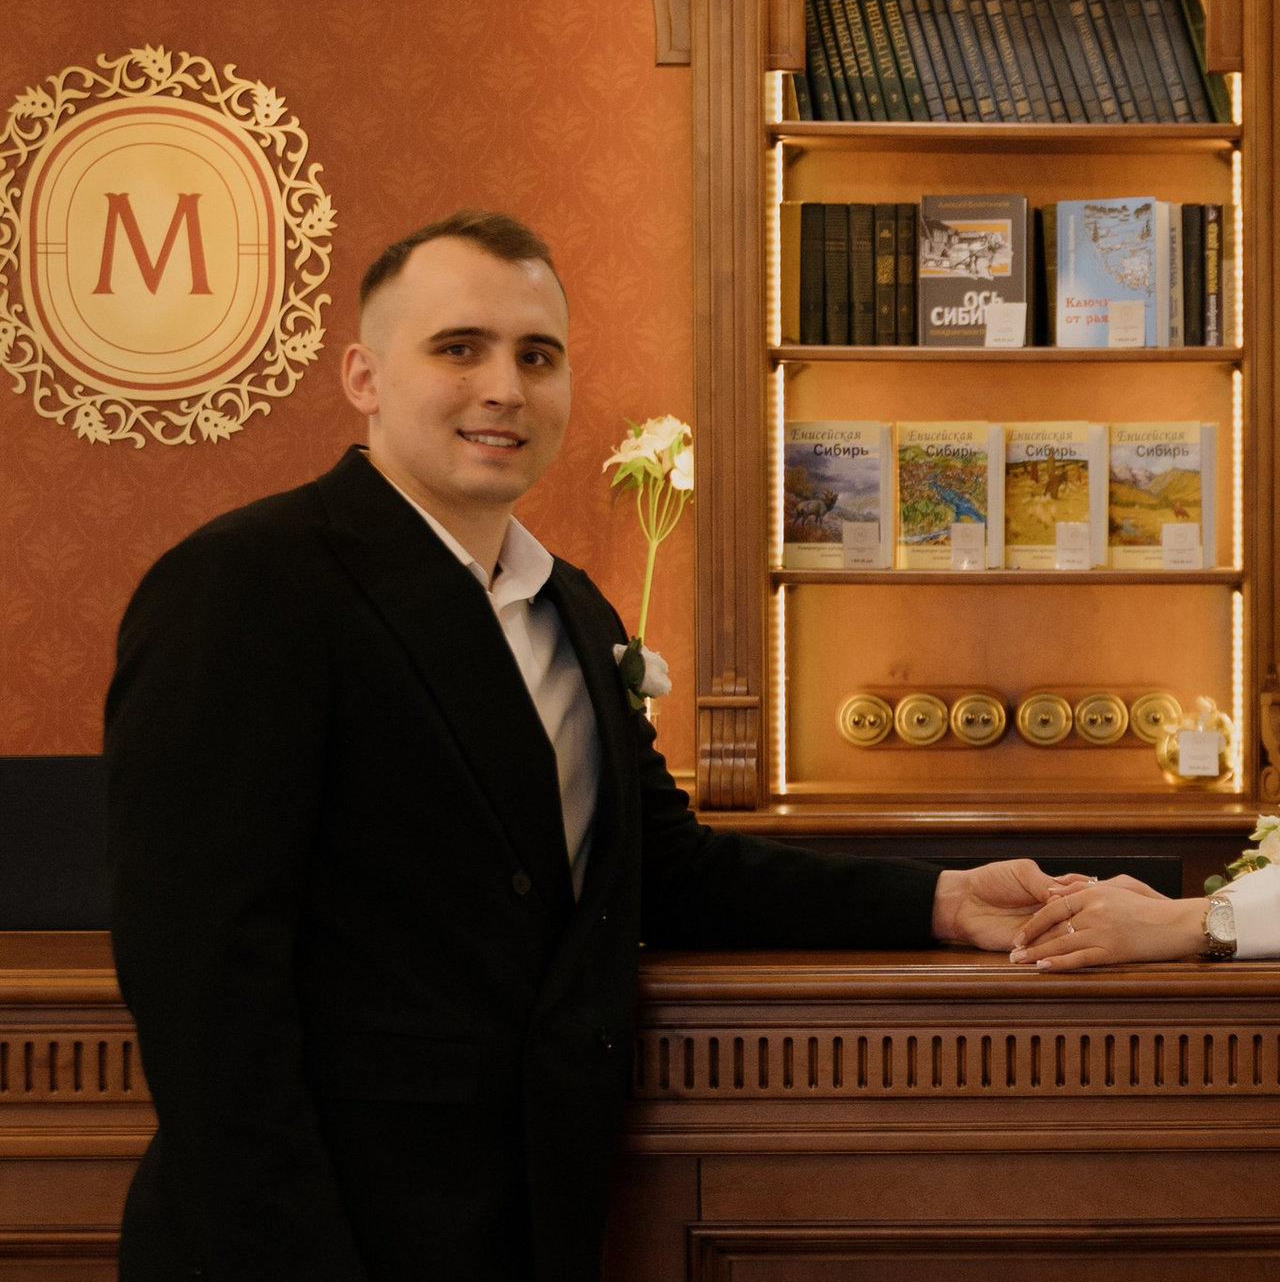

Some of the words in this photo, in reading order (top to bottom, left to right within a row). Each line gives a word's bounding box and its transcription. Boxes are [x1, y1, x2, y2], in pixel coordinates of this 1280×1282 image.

[91, 192, 215, 295] M
[963, 291, 1005, 309] ОСЬ
[930, 306, 988, 326] СИБИ
[1065, 316, 1082, 324] от
[1086, 315, 1109, 326] рая
[790, 428, 861, 442] Енисейская
[907, 429, 973, 442] Енисейская
[1007, 429, 1073, 442] Енисейская
[1116, 429, 1185, 442] Енисейская
[813, 443, 869, 459] Сибирь
[925, 444, 977, 459] Сибирь
[1025, 444, 1077, 459] Сибирь
[1136, 444, 1190, 459] Сибирь
